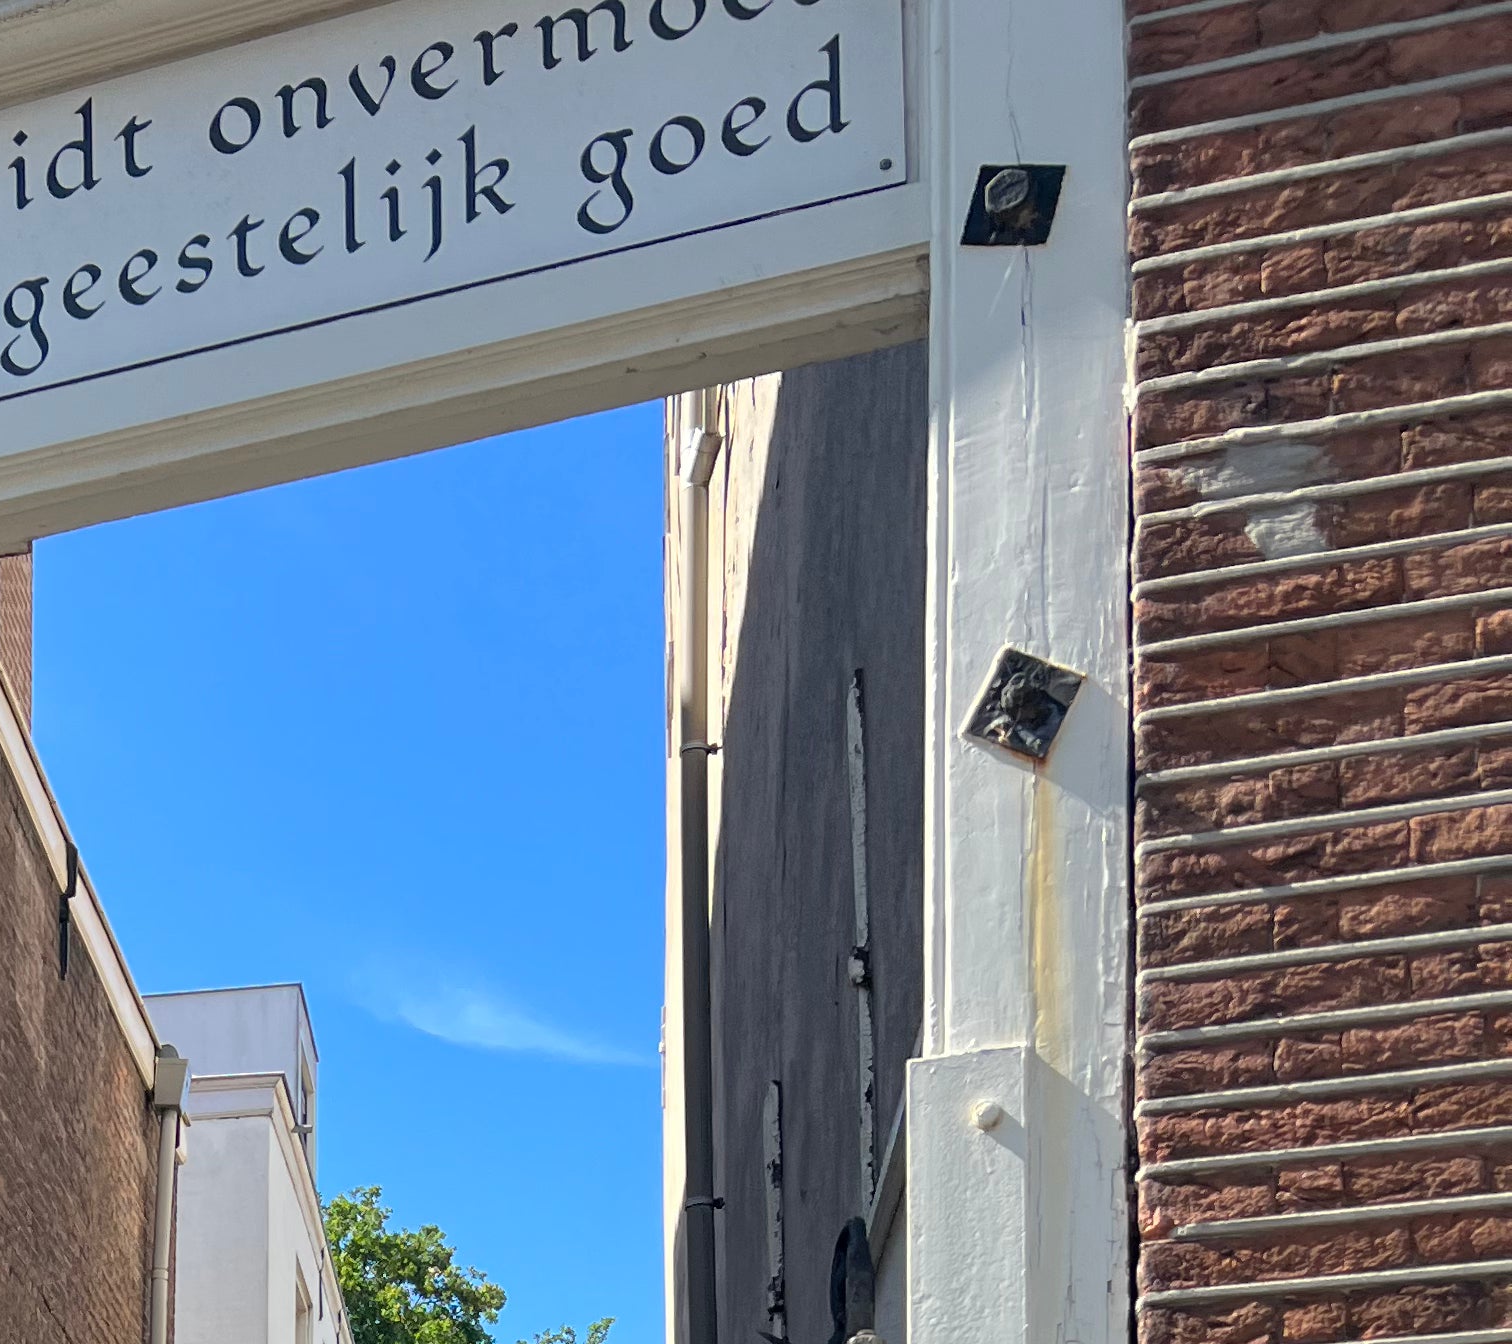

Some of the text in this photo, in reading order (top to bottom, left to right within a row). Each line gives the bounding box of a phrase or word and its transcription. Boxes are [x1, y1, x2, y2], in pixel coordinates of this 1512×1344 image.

[209, 0, 821, 154] onvermo
[0, 125, 516, 376] geestelijk
[577, 34, 851, 234] goed
